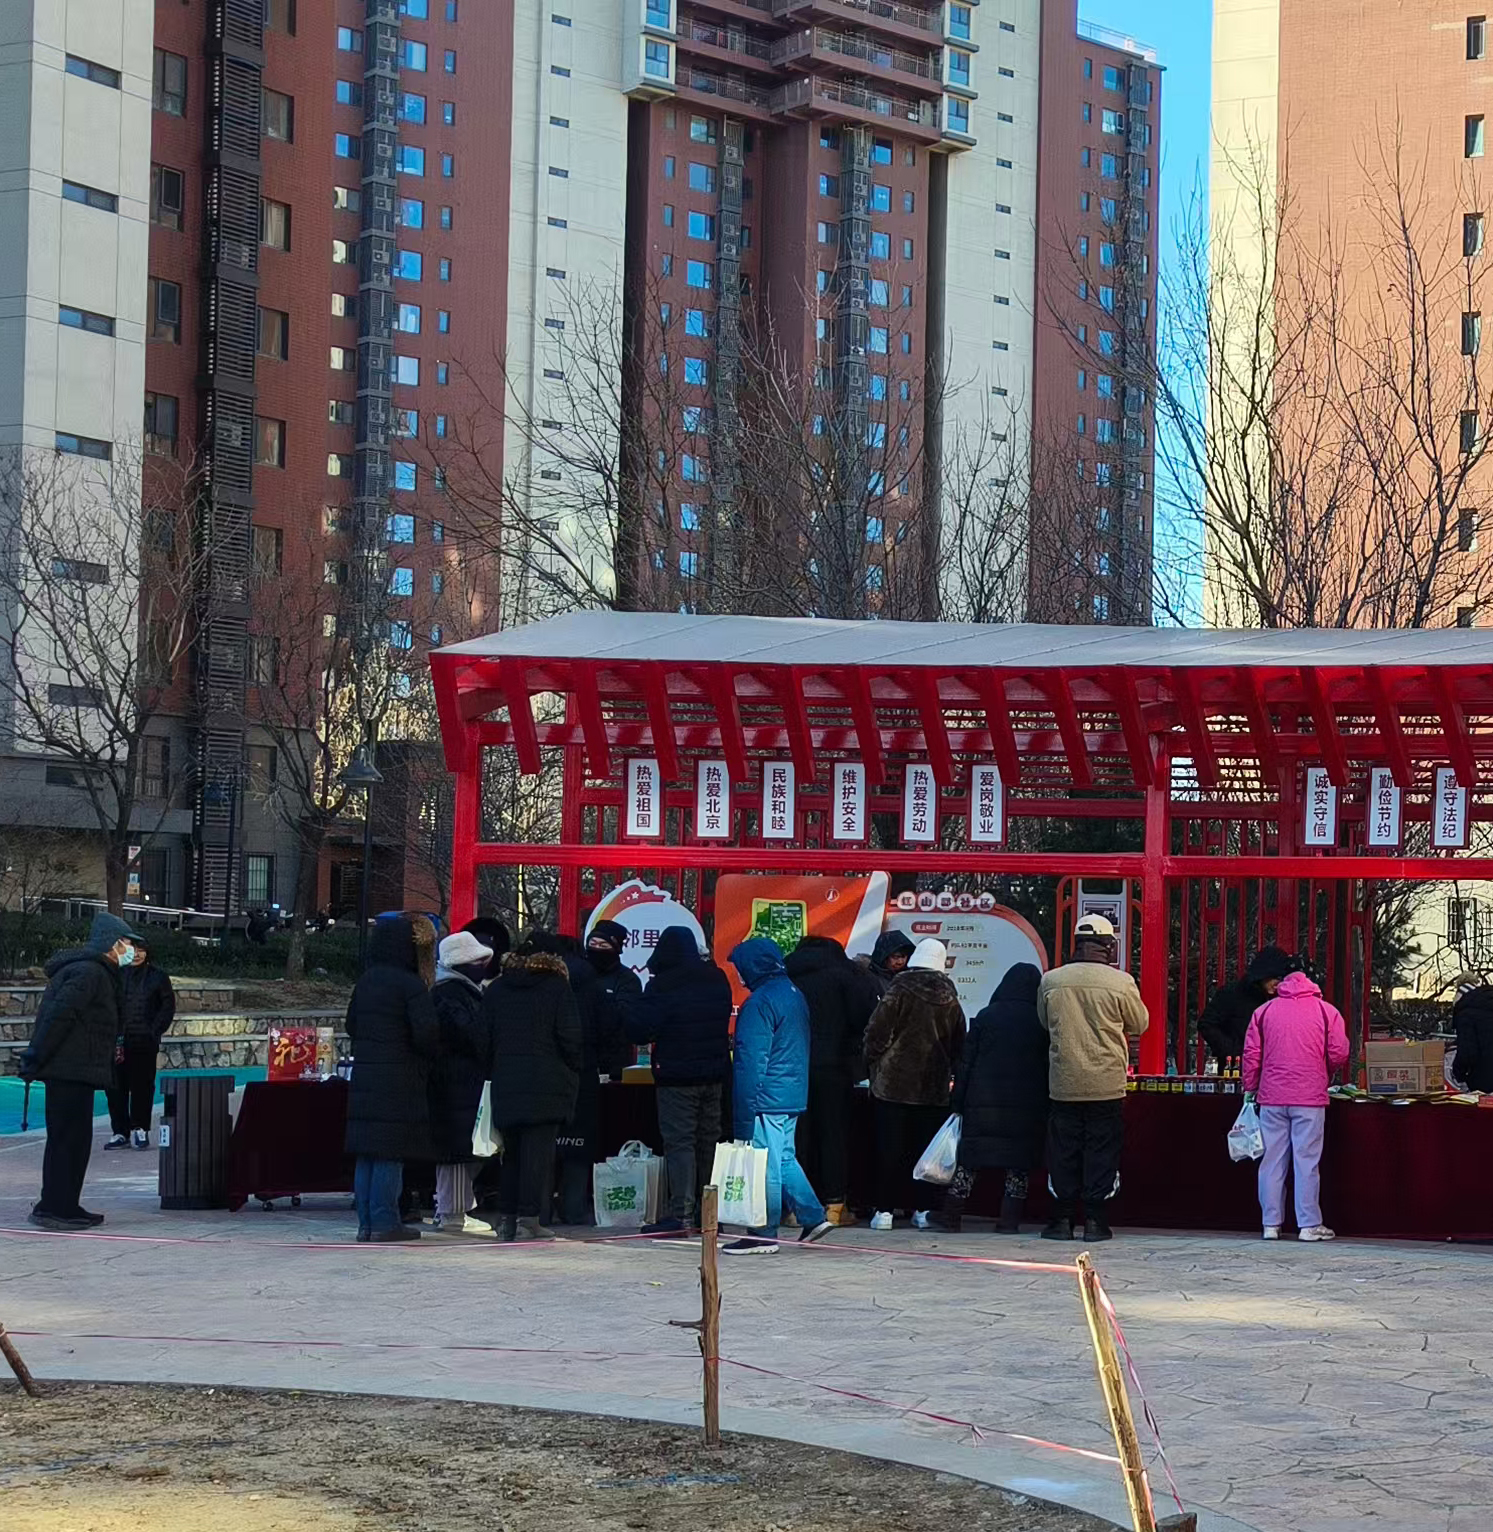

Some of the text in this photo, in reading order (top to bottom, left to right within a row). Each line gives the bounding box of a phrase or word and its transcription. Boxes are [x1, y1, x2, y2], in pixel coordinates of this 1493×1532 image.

[635, 764, 652, 829] 热爱祖国
[705, 766, 723, 830] 热爱北京
[771, 768, 787, 831] 民族和睦
[841, 769, 858, 832] 维护安全
[912, 770, 929, 834] 热爱劳动
[979, 771, 995, 835] 爱岗敬业
[1313, 774, 1329, 837] 诚实守信
[1377, 774, 1393, 838] 勤俭节约
[1442, 774, 1458, 839] 遵守法纪
